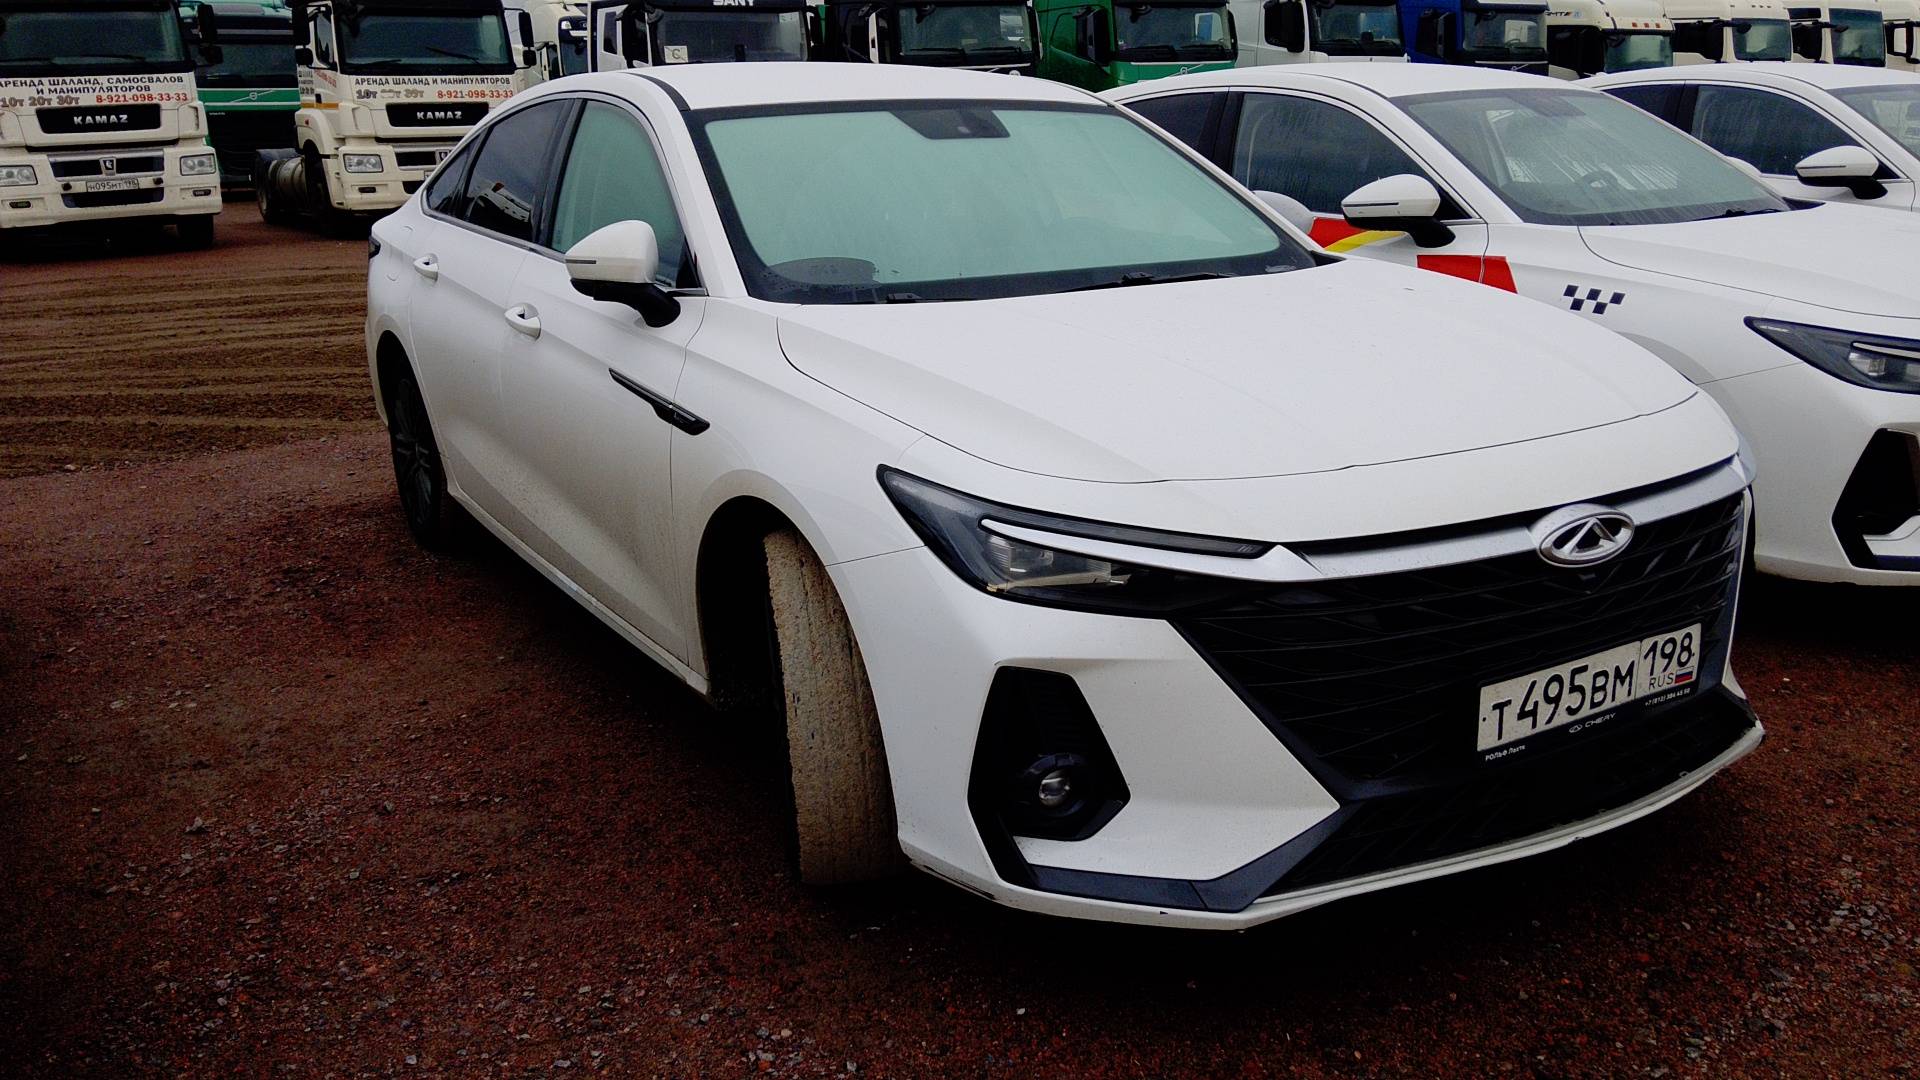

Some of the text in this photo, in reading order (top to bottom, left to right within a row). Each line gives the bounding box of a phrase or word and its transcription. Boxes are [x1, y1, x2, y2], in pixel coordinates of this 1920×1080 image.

[48, 78, 103, 86] ШАЛАНД,
[107, 76, 184, 84] САМОСВАЛОВ
[355, 77, 390, 86] АРЕНДА
[392, 77, 430, 86] ШАЛАНД
[440, 77, 510, 85] МАНИПУЛЯТОРОВ
[48, 85, 151, 94] МАНИПУЛЯТОРОВ
[437, 90, 514, 99] 8-921-098-33-33
[96, 93, 187, 103] 8-921-098-33-33
[74, 114, 128, 125] KAMAZ
[416, 111, 462, 120] KAMAZ
[1643, 631, 1694, 677] 198
[1649, 672, 1675, 691] RUS
[1585, 712, 1616, 728] CHERY
